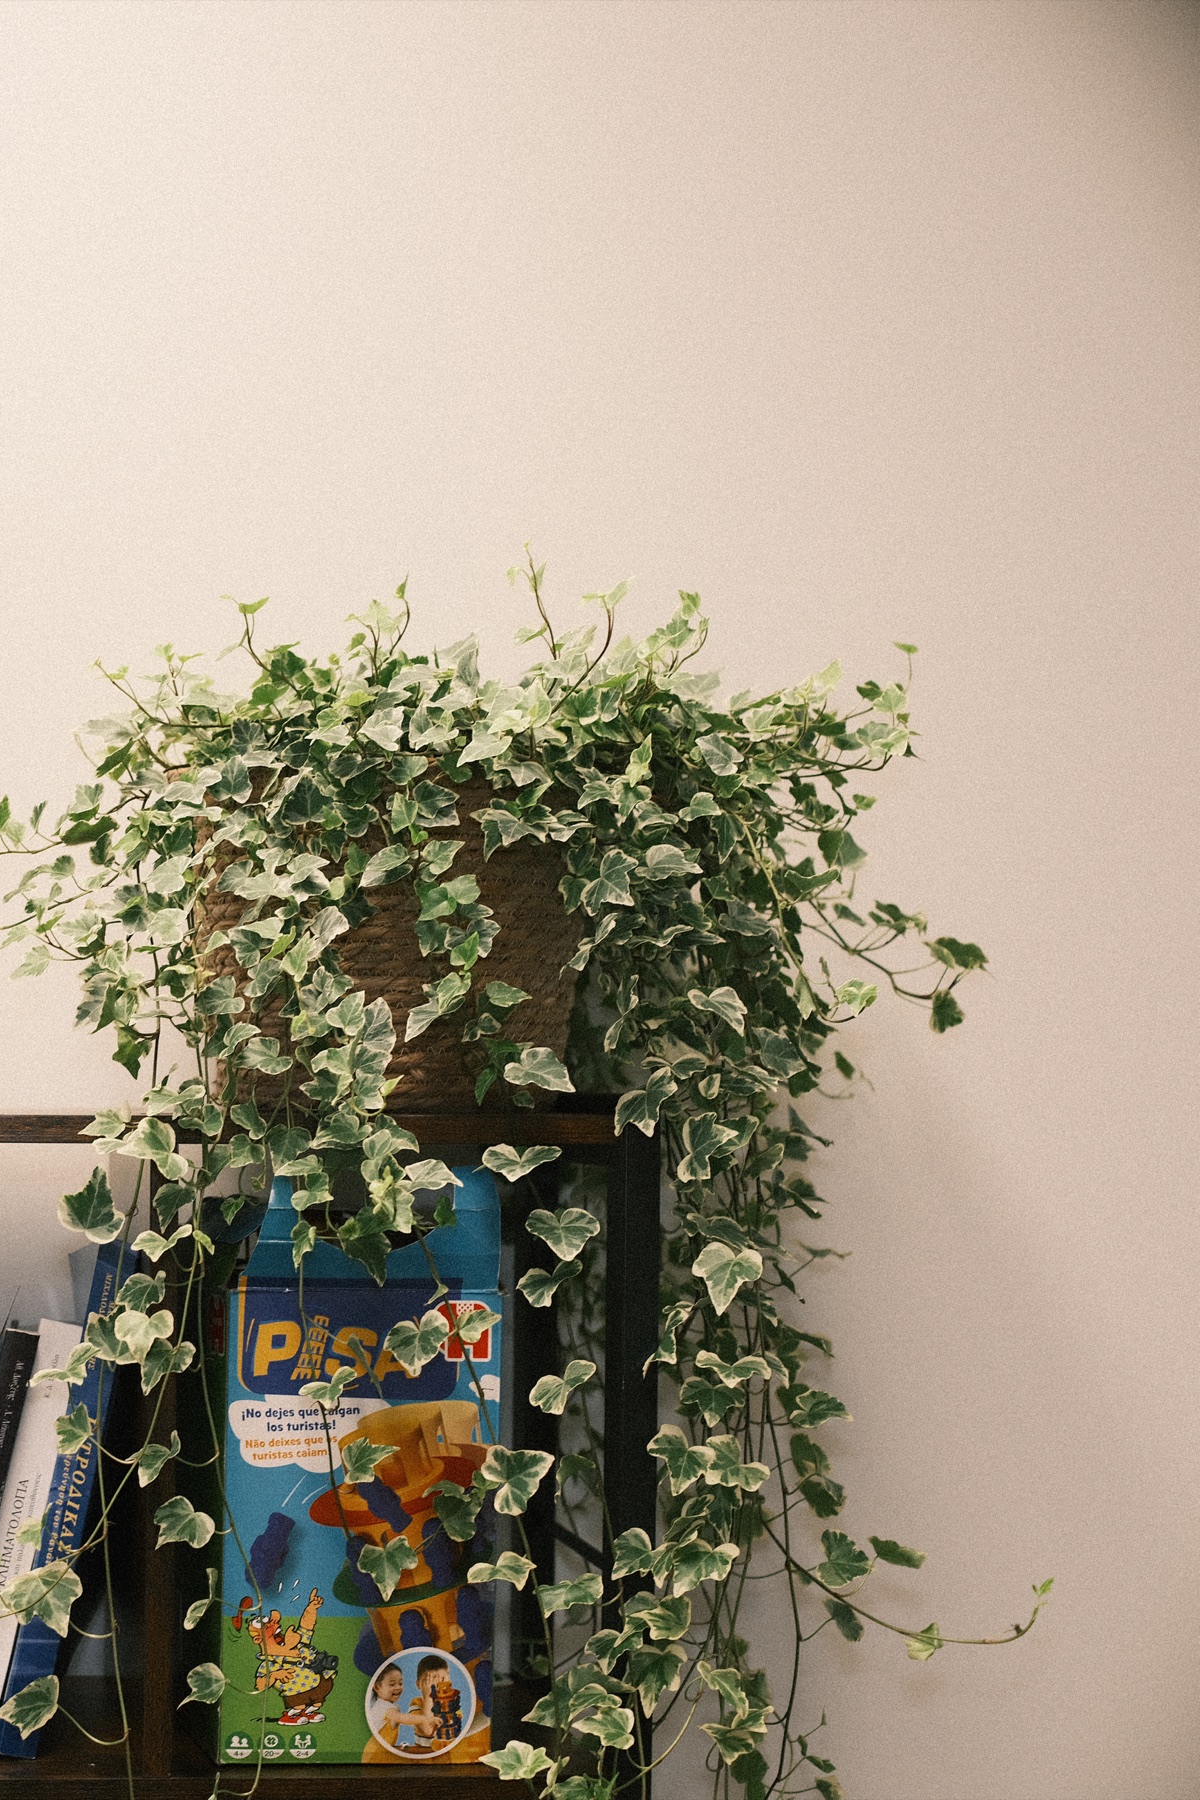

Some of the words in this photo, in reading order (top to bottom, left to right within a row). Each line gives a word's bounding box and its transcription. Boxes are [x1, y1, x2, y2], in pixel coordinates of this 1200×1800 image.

[242, 1408, 261, 1421] ¡No
[265, 1408, 294, 1420] dejes
[298, 1408, 319, 1420] que
[267, 1422, 283, 1432] los
[287, 1420, 336, 1431] turistas!
[245, 1439, 265, 1449] Não
[268, 1437, 300, 1447] deixes
[304, 1436, 323, 1447] que
[252, 1450, 293, 1461] turistas
[296, 1448, 328, 1458] caiam
